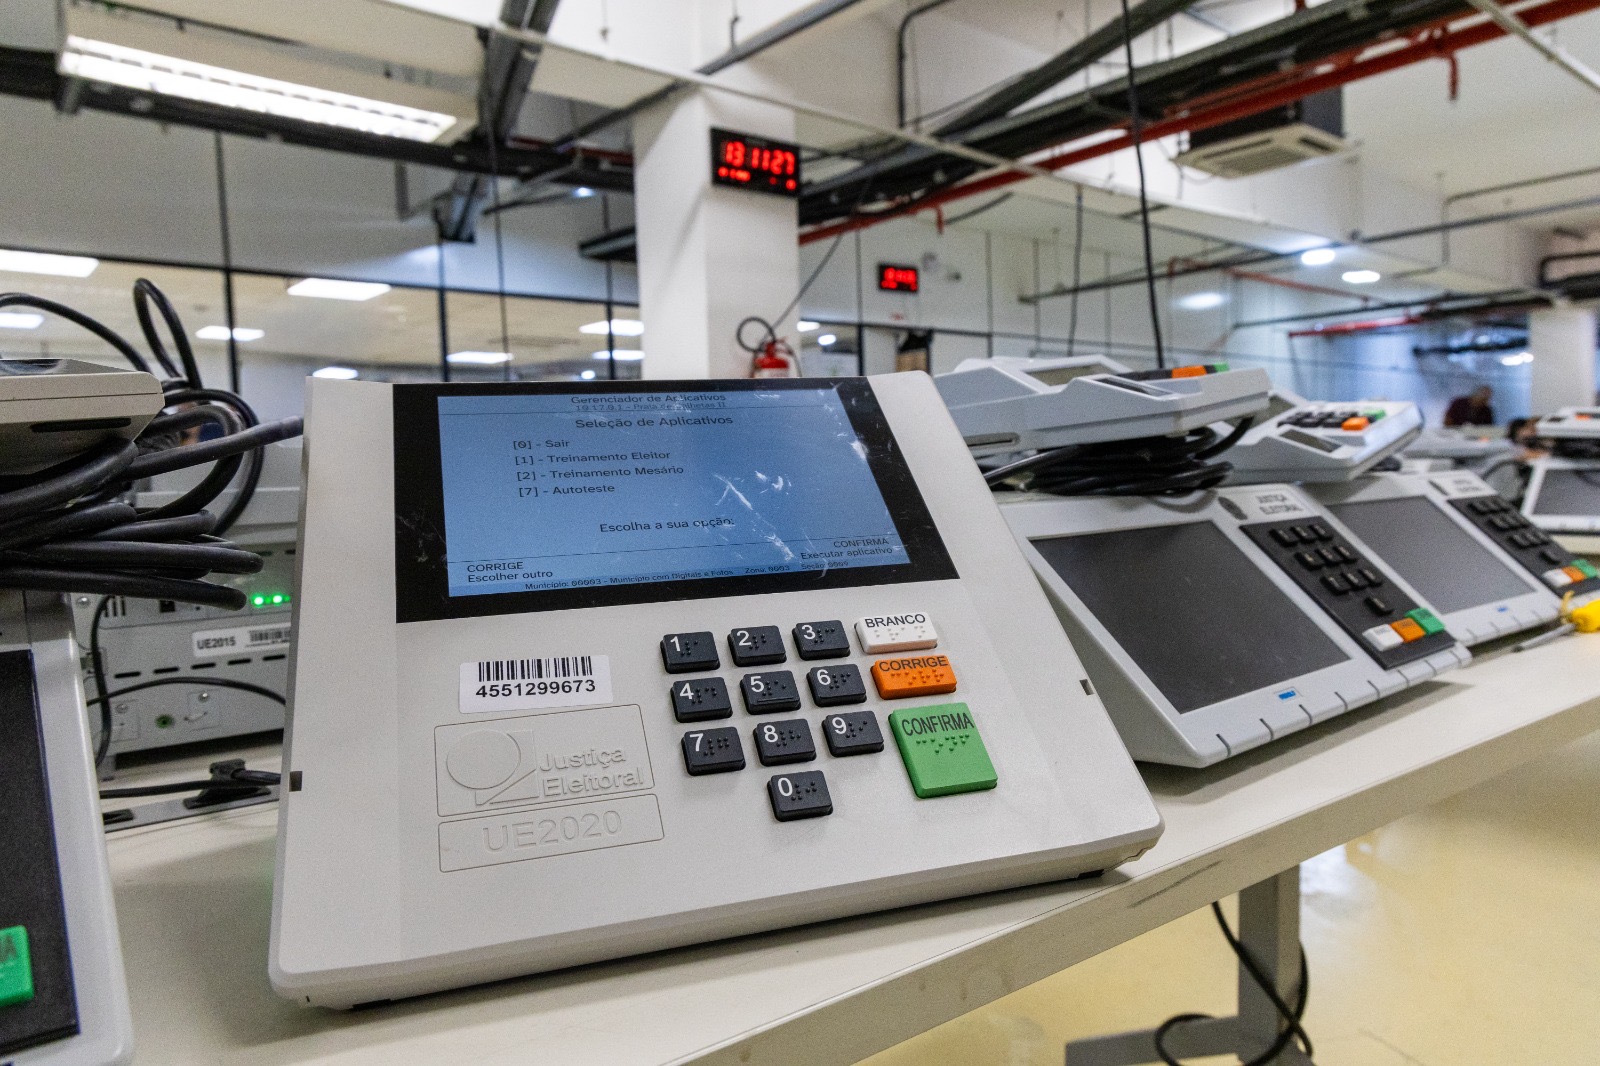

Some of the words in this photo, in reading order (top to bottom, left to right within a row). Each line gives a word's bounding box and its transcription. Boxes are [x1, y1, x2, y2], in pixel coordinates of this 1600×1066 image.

[571, 395, 643, 404] Gerenciador
[575, 415, 633, 429] Seleção
[637, 417, 655, 427] de
[659, 415, 733, 428] Aplicativos
[513, 440, 532, 450] [0]
[545, 440, 570, 449] Sair
[515, 455, 534, 466] [1]
[548, 452, 628, 464] Treinamento
[632, 451, 671, 460] Eleitor
[517, 471, 536, 482] [2]
[549, 468, 631, 479] Treinamento
[635, 465, 684, 475] Mesário
[519, 486, 539, 498] [7]
[552, 484, 615, 495] Autoteste
[600, 521, 651, 533] Escolha
[655, 522, 663, 530] a
[666, 520, 689, 529] sua
[833, 537, 890, 549] CONFIRMA
[800, 550, 844, 560] Executar
[847, 546, 893, 558] aplicativo
[467, 561, 524, 573] CORRIGE
[467, 572, 519, 583] Escolher
[522, 570, 554, 579] outro
[672, 571, 701, 580] Digitais
[865, 613, 926, 628] BRANCO
[736, 631, 751, 647] 2
[801, 624, 816, 640] 3
[197, 636, 235, 649] UE2015
[671, 636, 680, 652] 1
[879, 655, 948, 672] CORRIGE
[750, 676, 765, 693] 5
[816, 669, 831, 686] 6
[475, 679, 596, 698] 4551299673
[679, 683, 694, 700] 4
[832, 717, 847, 734] 9
[901, 712, 975, 737] CONFIRMA
[763, 725, 779, 743] 8
[689, 733, 704, 752] 7
[539, 747, 627, 772] Justiça
[542, 767, 644, 798] Eleitoral
[777, 778, 793, 797] 0
[482, 810, 623, 852] UE2020
